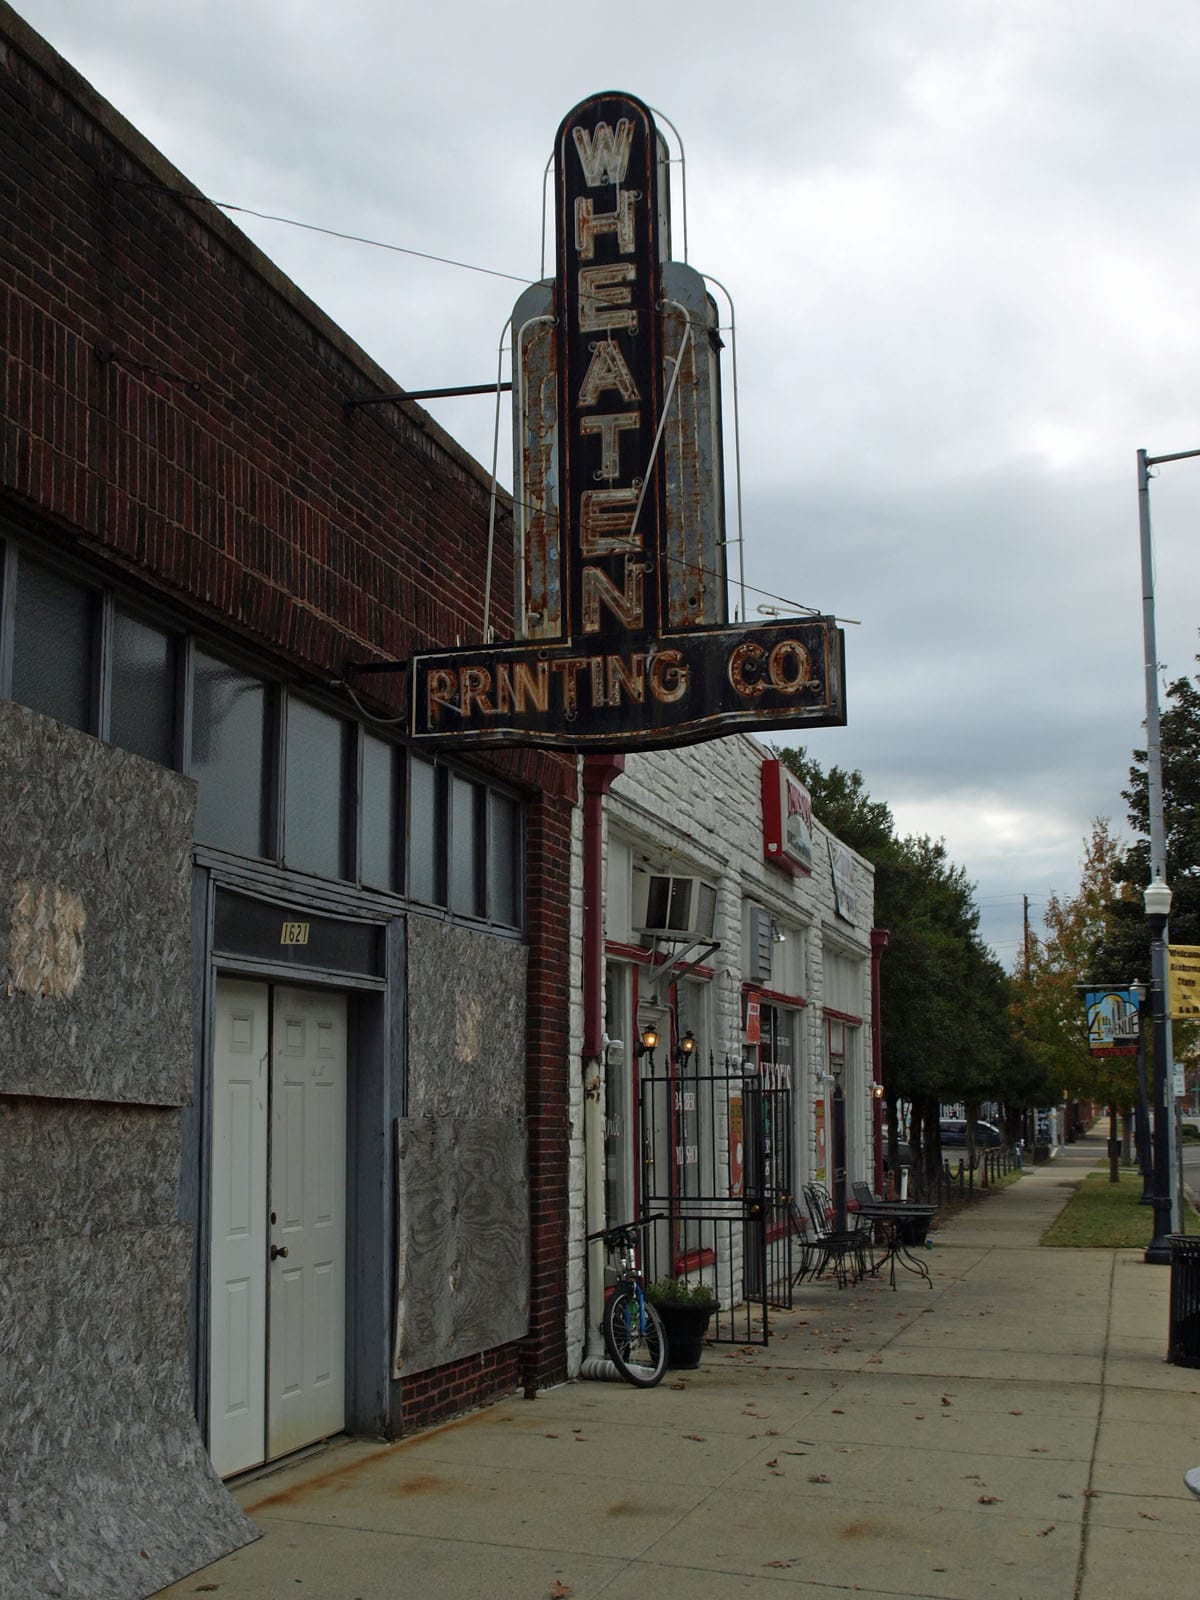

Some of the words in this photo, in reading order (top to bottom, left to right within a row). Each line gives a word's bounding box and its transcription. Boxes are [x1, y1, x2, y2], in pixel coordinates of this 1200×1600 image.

[572, 117, 645, 632] WHEATEN
[426, 650, 690, 720] PRINTING
[727, 639, 813, 697] CO
[283, 923, 308, 943] 1621
